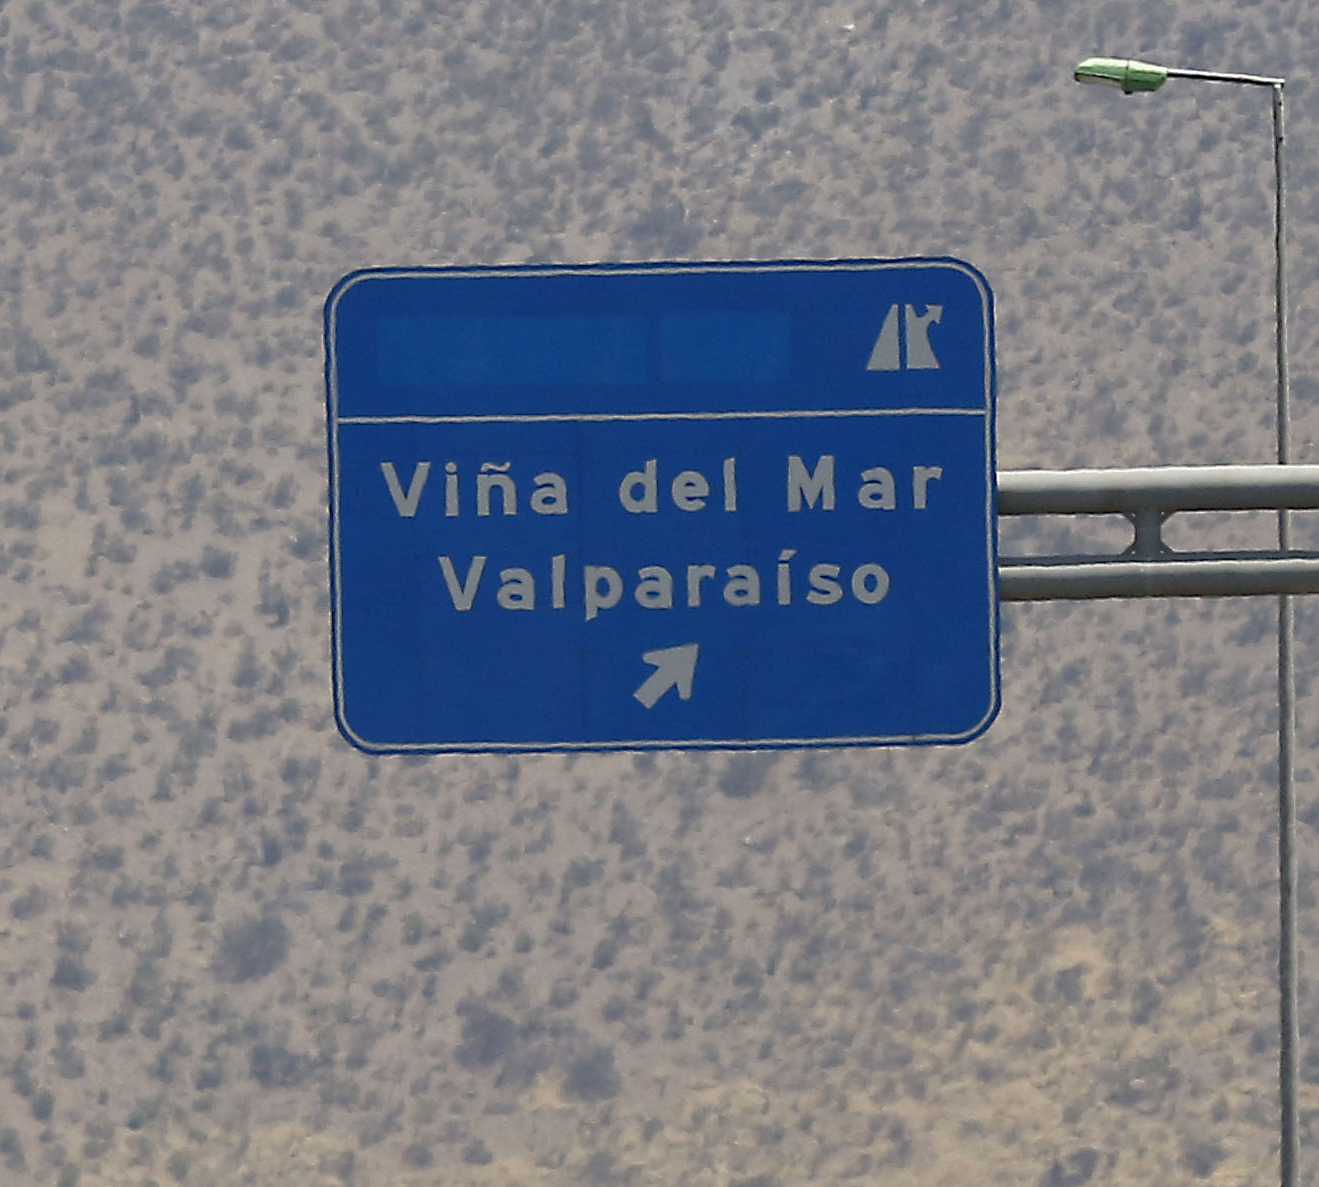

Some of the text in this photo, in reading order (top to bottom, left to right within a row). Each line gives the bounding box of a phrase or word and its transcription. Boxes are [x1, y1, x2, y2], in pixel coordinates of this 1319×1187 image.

[379, 454, 943, 517] Viña del Mar
[438, 549, 891, 621] Valparaíso
